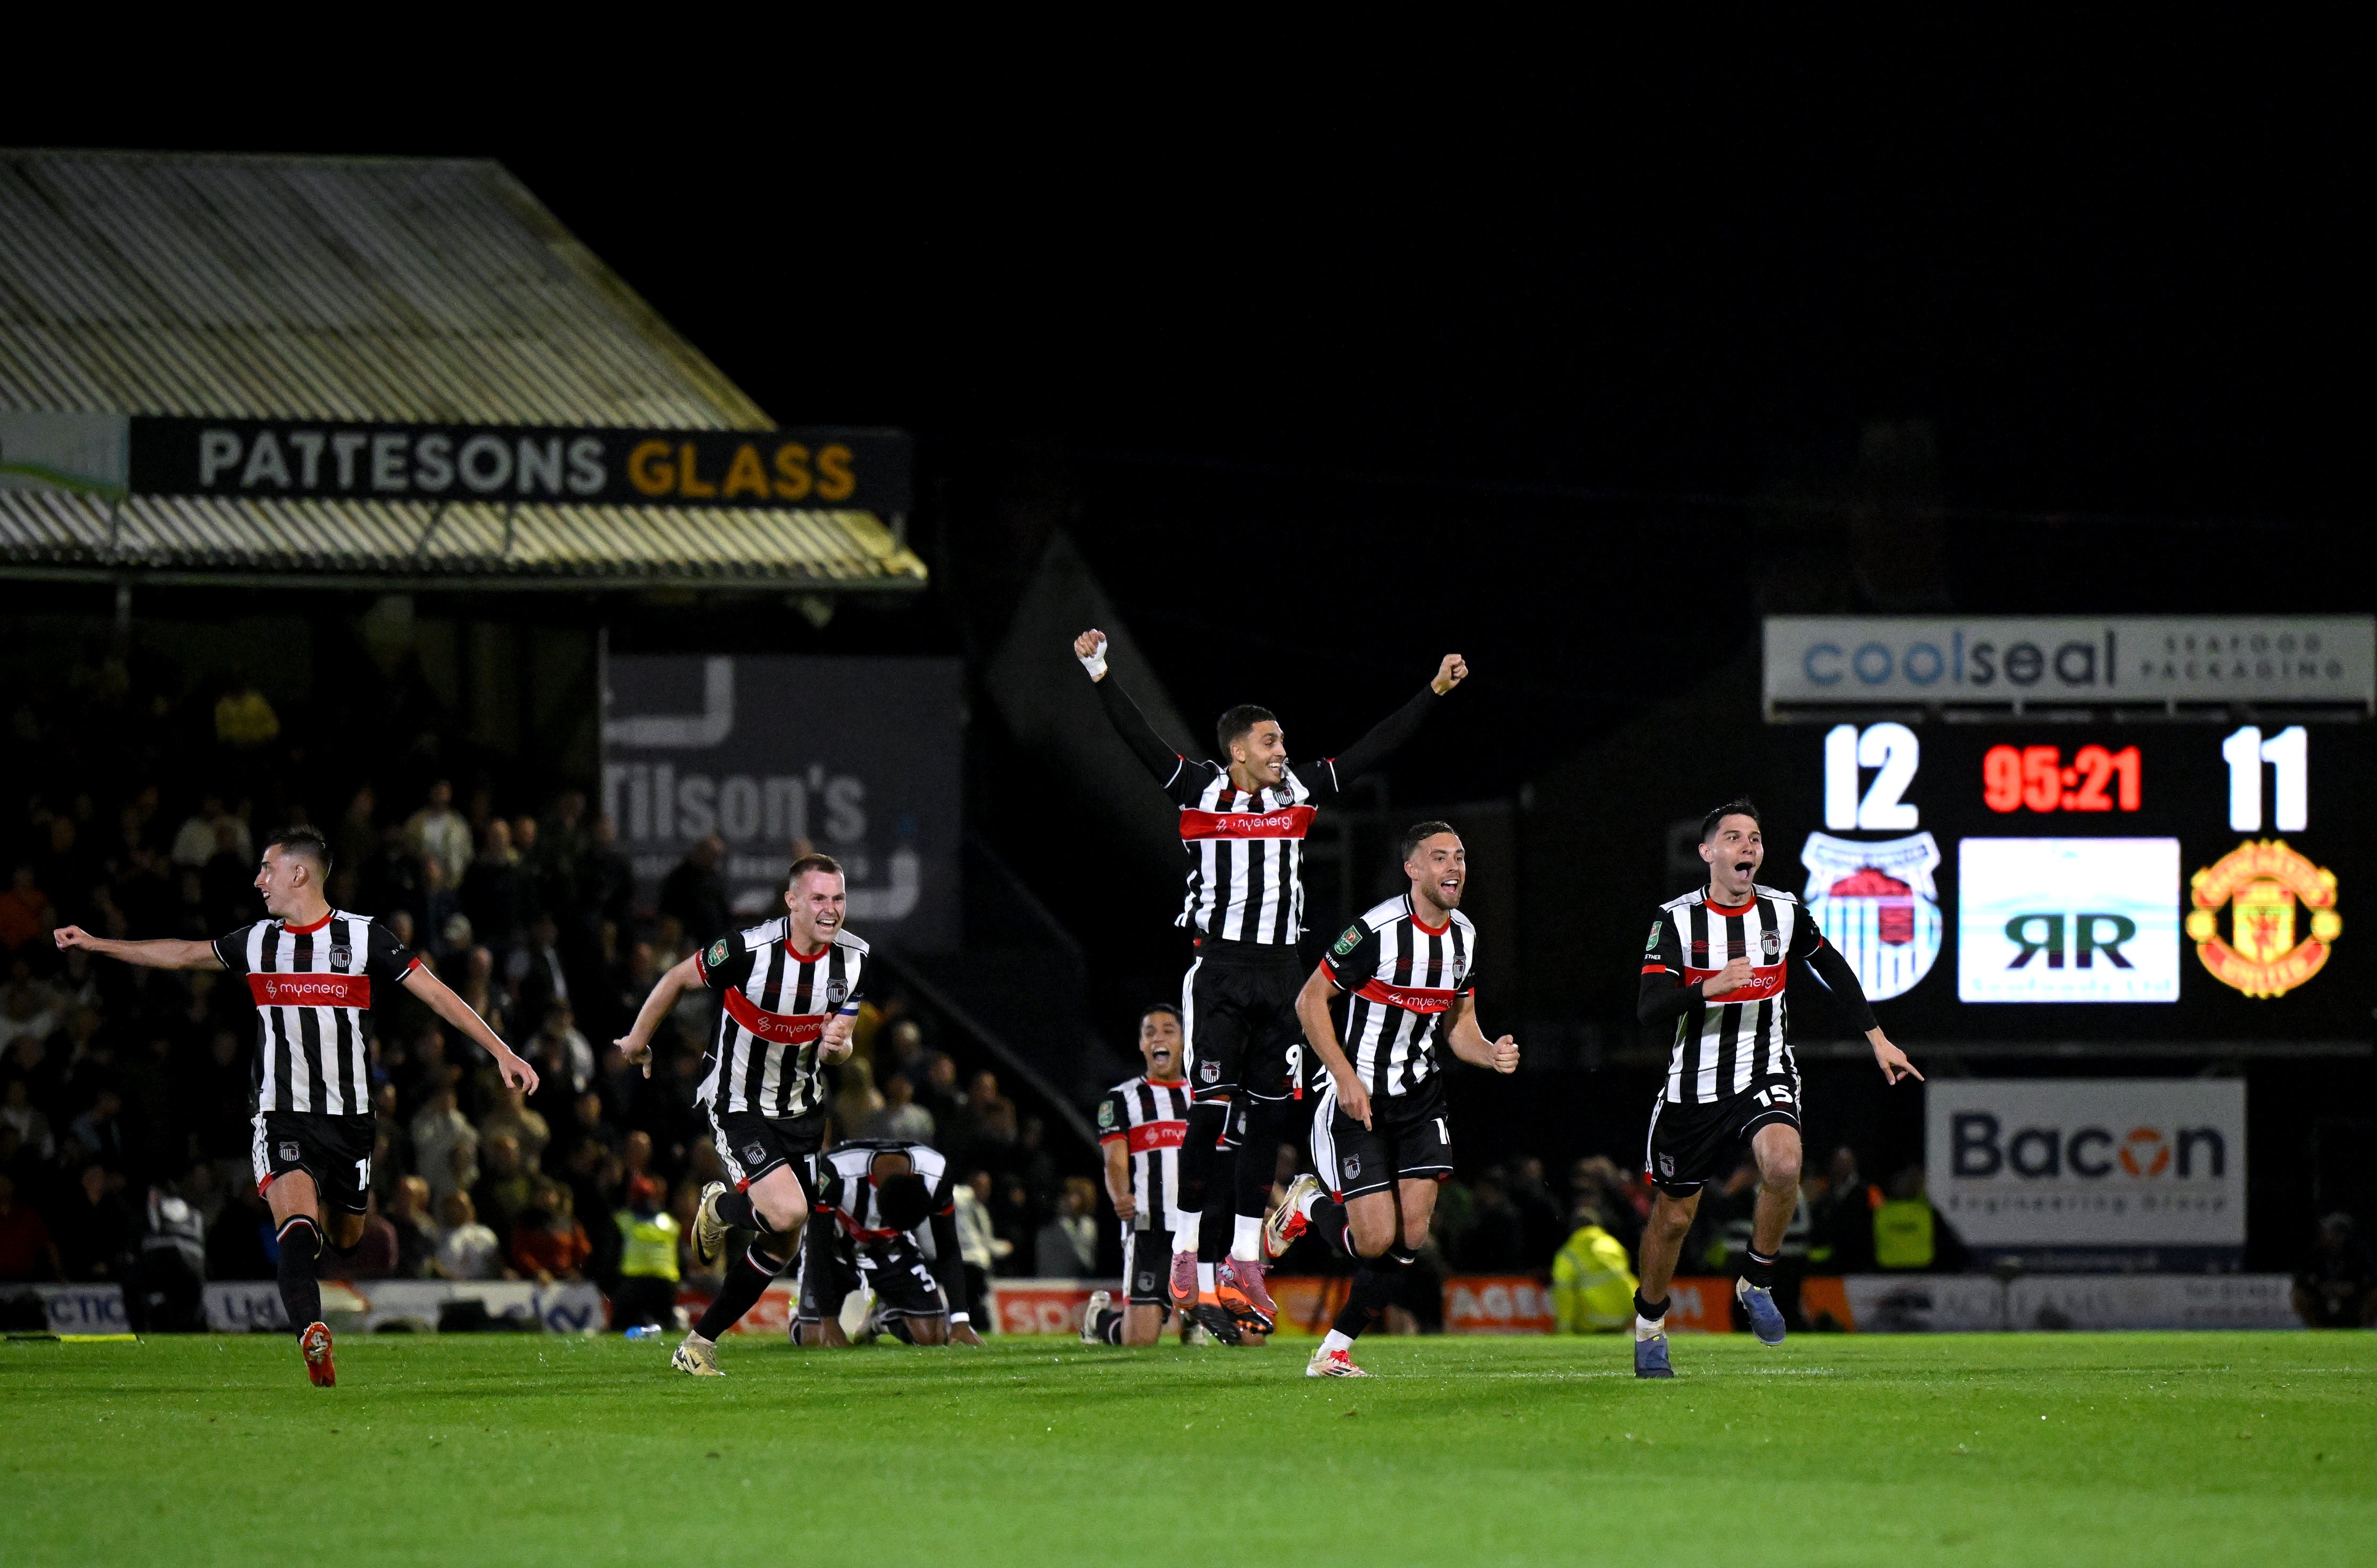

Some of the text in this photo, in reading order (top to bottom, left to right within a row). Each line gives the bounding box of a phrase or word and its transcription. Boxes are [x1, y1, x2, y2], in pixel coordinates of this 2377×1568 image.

[198, 428, 857, 502] PATTESONS GLASS
[1803, 630, 2116, 688] coolseal
[1824, 721, 1919, 830] 12
[1983, 745, 2142, 813] 95:21
[2222, 725, 2308, 832] 11
[280, 983, 348, 998] myenergi
[775, 1023, 822, 1038] myene
[1285, 1044, 1301, 1075] 9
[1753, 1085, 1793, 1107] 15
[1431, 1117, 1451, 1145] 1
[1950, 1111, 2226, 1179] Bacon
[355, 1151, 371, 1191] 1
[910, 1263, 937, 1292] 3
